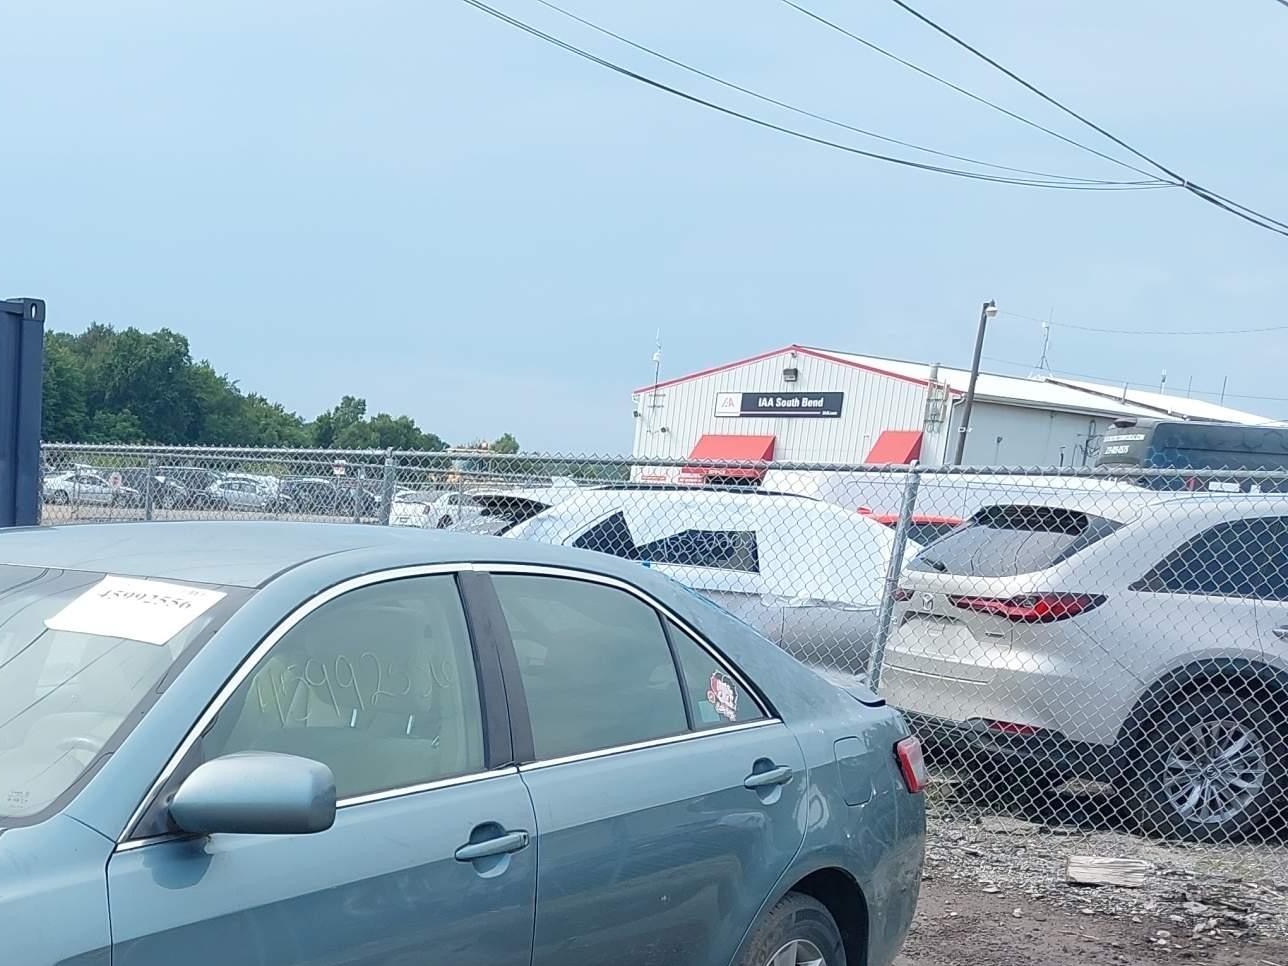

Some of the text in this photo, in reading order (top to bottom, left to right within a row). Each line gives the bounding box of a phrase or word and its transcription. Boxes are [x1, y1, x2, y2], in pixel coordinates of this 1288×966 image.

[758, 397, 824, 408] IAA South Bend
